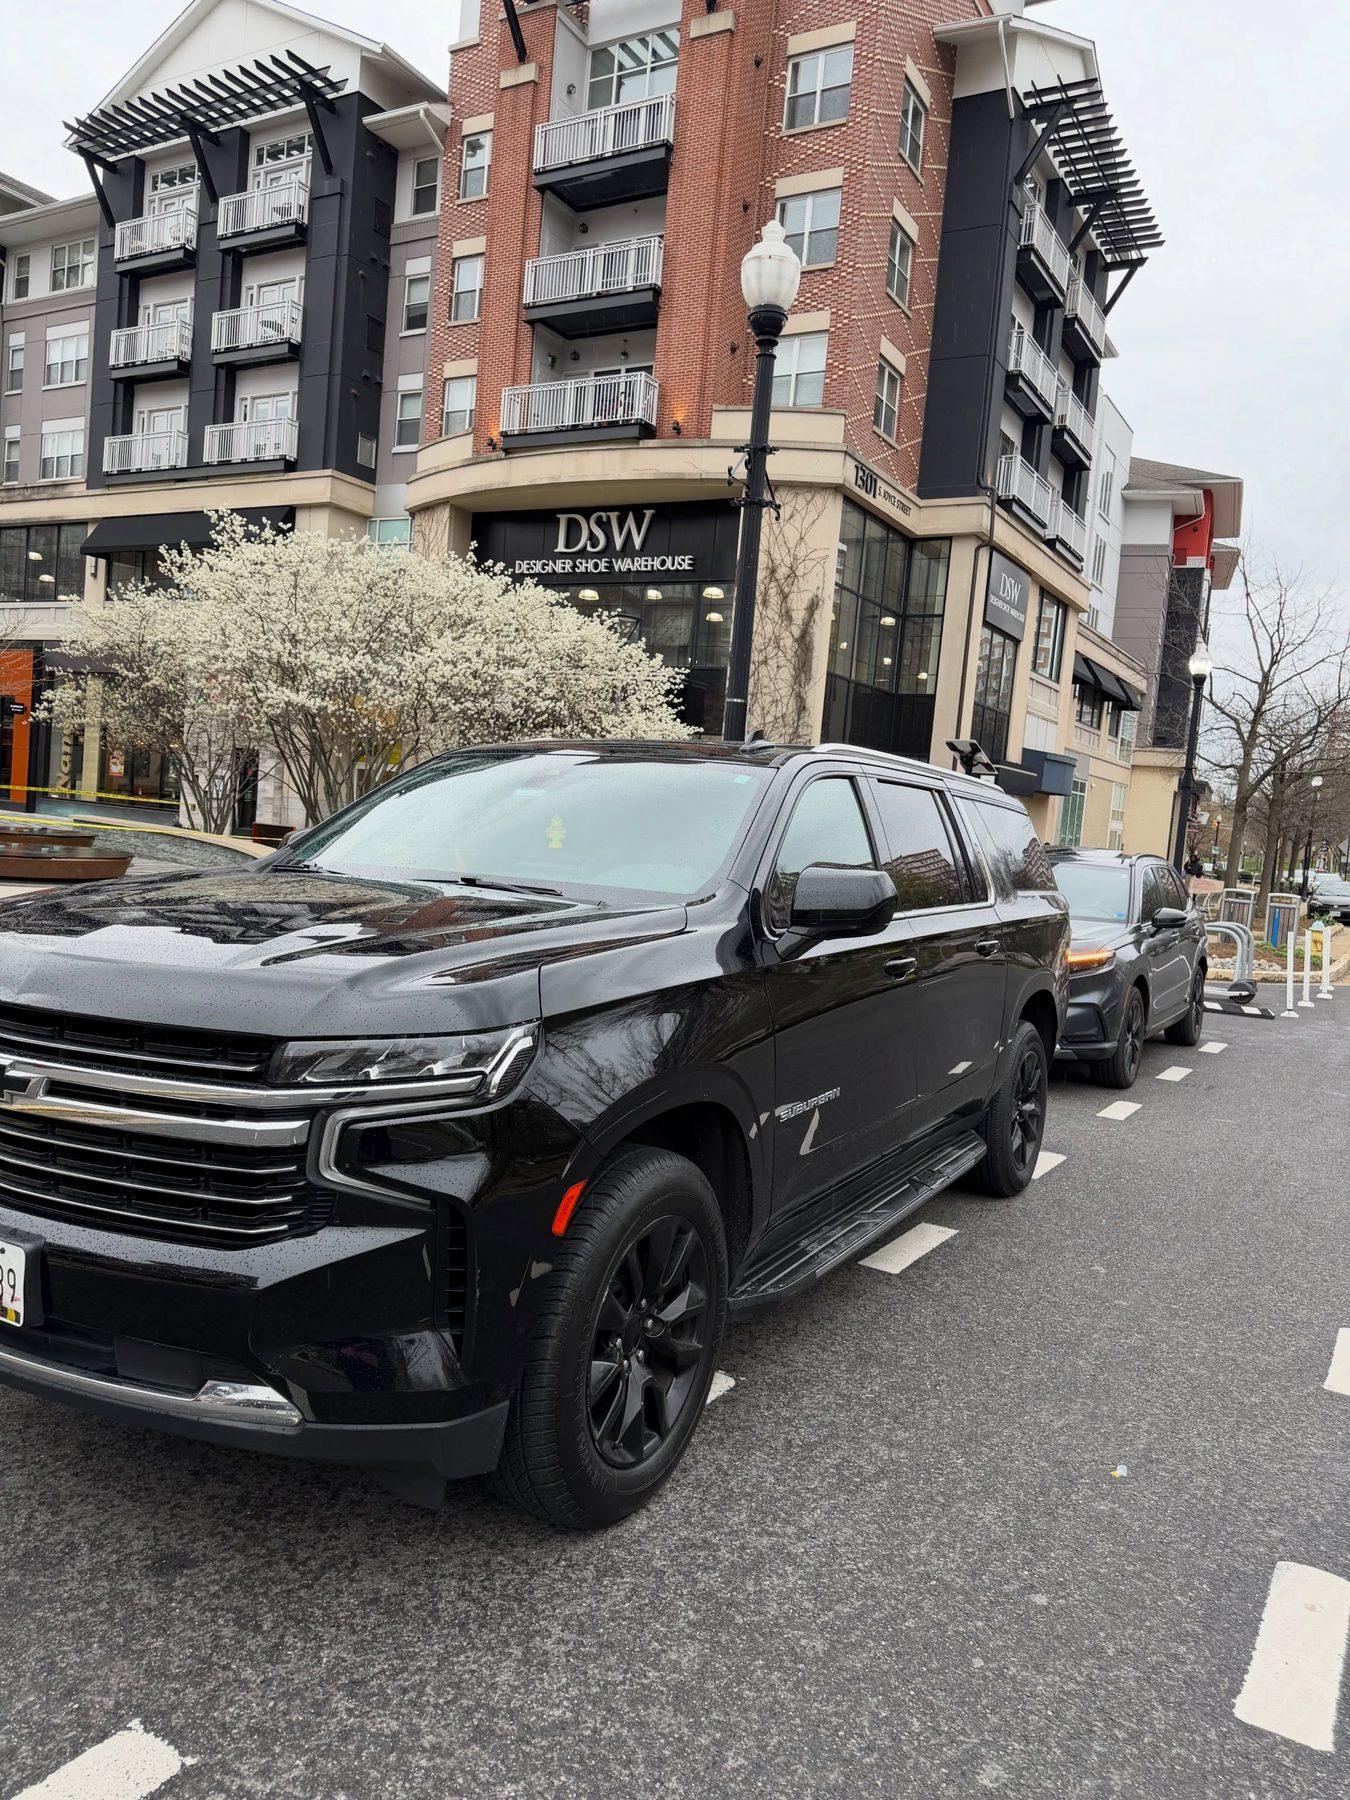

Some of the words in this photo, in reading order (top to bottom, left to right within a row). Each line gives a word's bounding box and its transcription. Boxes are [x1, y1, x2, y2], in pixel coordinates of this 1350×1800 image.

[855, 464, 877, 499] 1301
[554, 509, 656, 553] DSW
[515, 558, 573, 574] DESIGNER
[575, 557, 610, 573] SHOE
[612, 555, 694, 572] WAREHOUSE
[999, 572, 1022, 605] DSW
[779, 1086, 841, 1123] SUBURBAN
